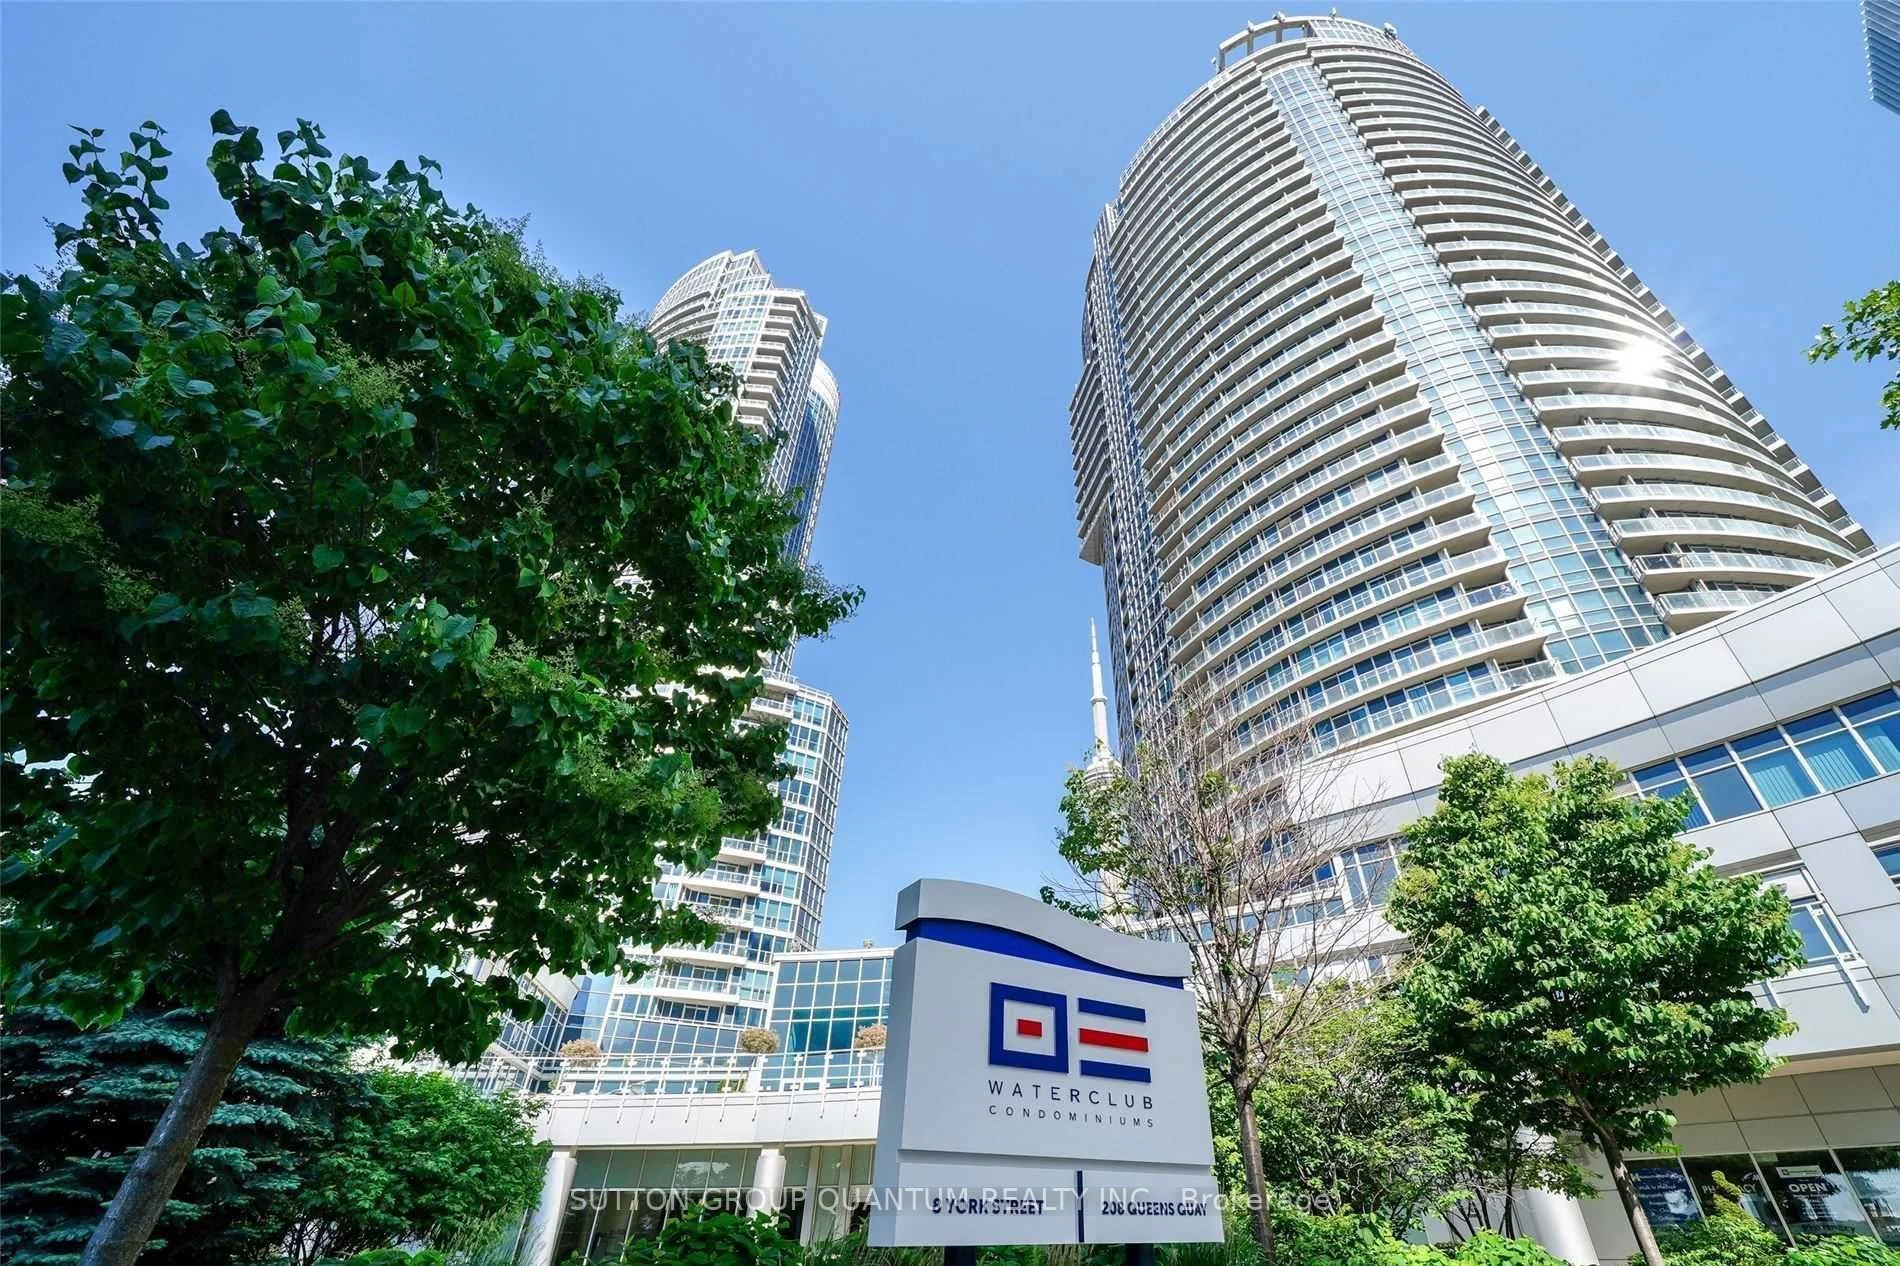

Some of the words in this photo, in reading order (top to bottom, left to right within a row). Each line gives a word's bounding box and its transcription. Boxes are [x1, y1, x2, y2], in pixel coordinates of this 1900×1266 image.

[988, 1079, 1153, 1110] WATERCLUB
[988, 1105, 1153, 1128] CONDOMINIUMS
[1788, 1182, 1829, 1194] OPEN
[946, 1198, 989, 1215] YORK
[992, 1198, 1044, 1215] STREET
[1127, 1201, 1175, 1216] QUEENS
[1177, 1202, 1207, 1217] QUAY
